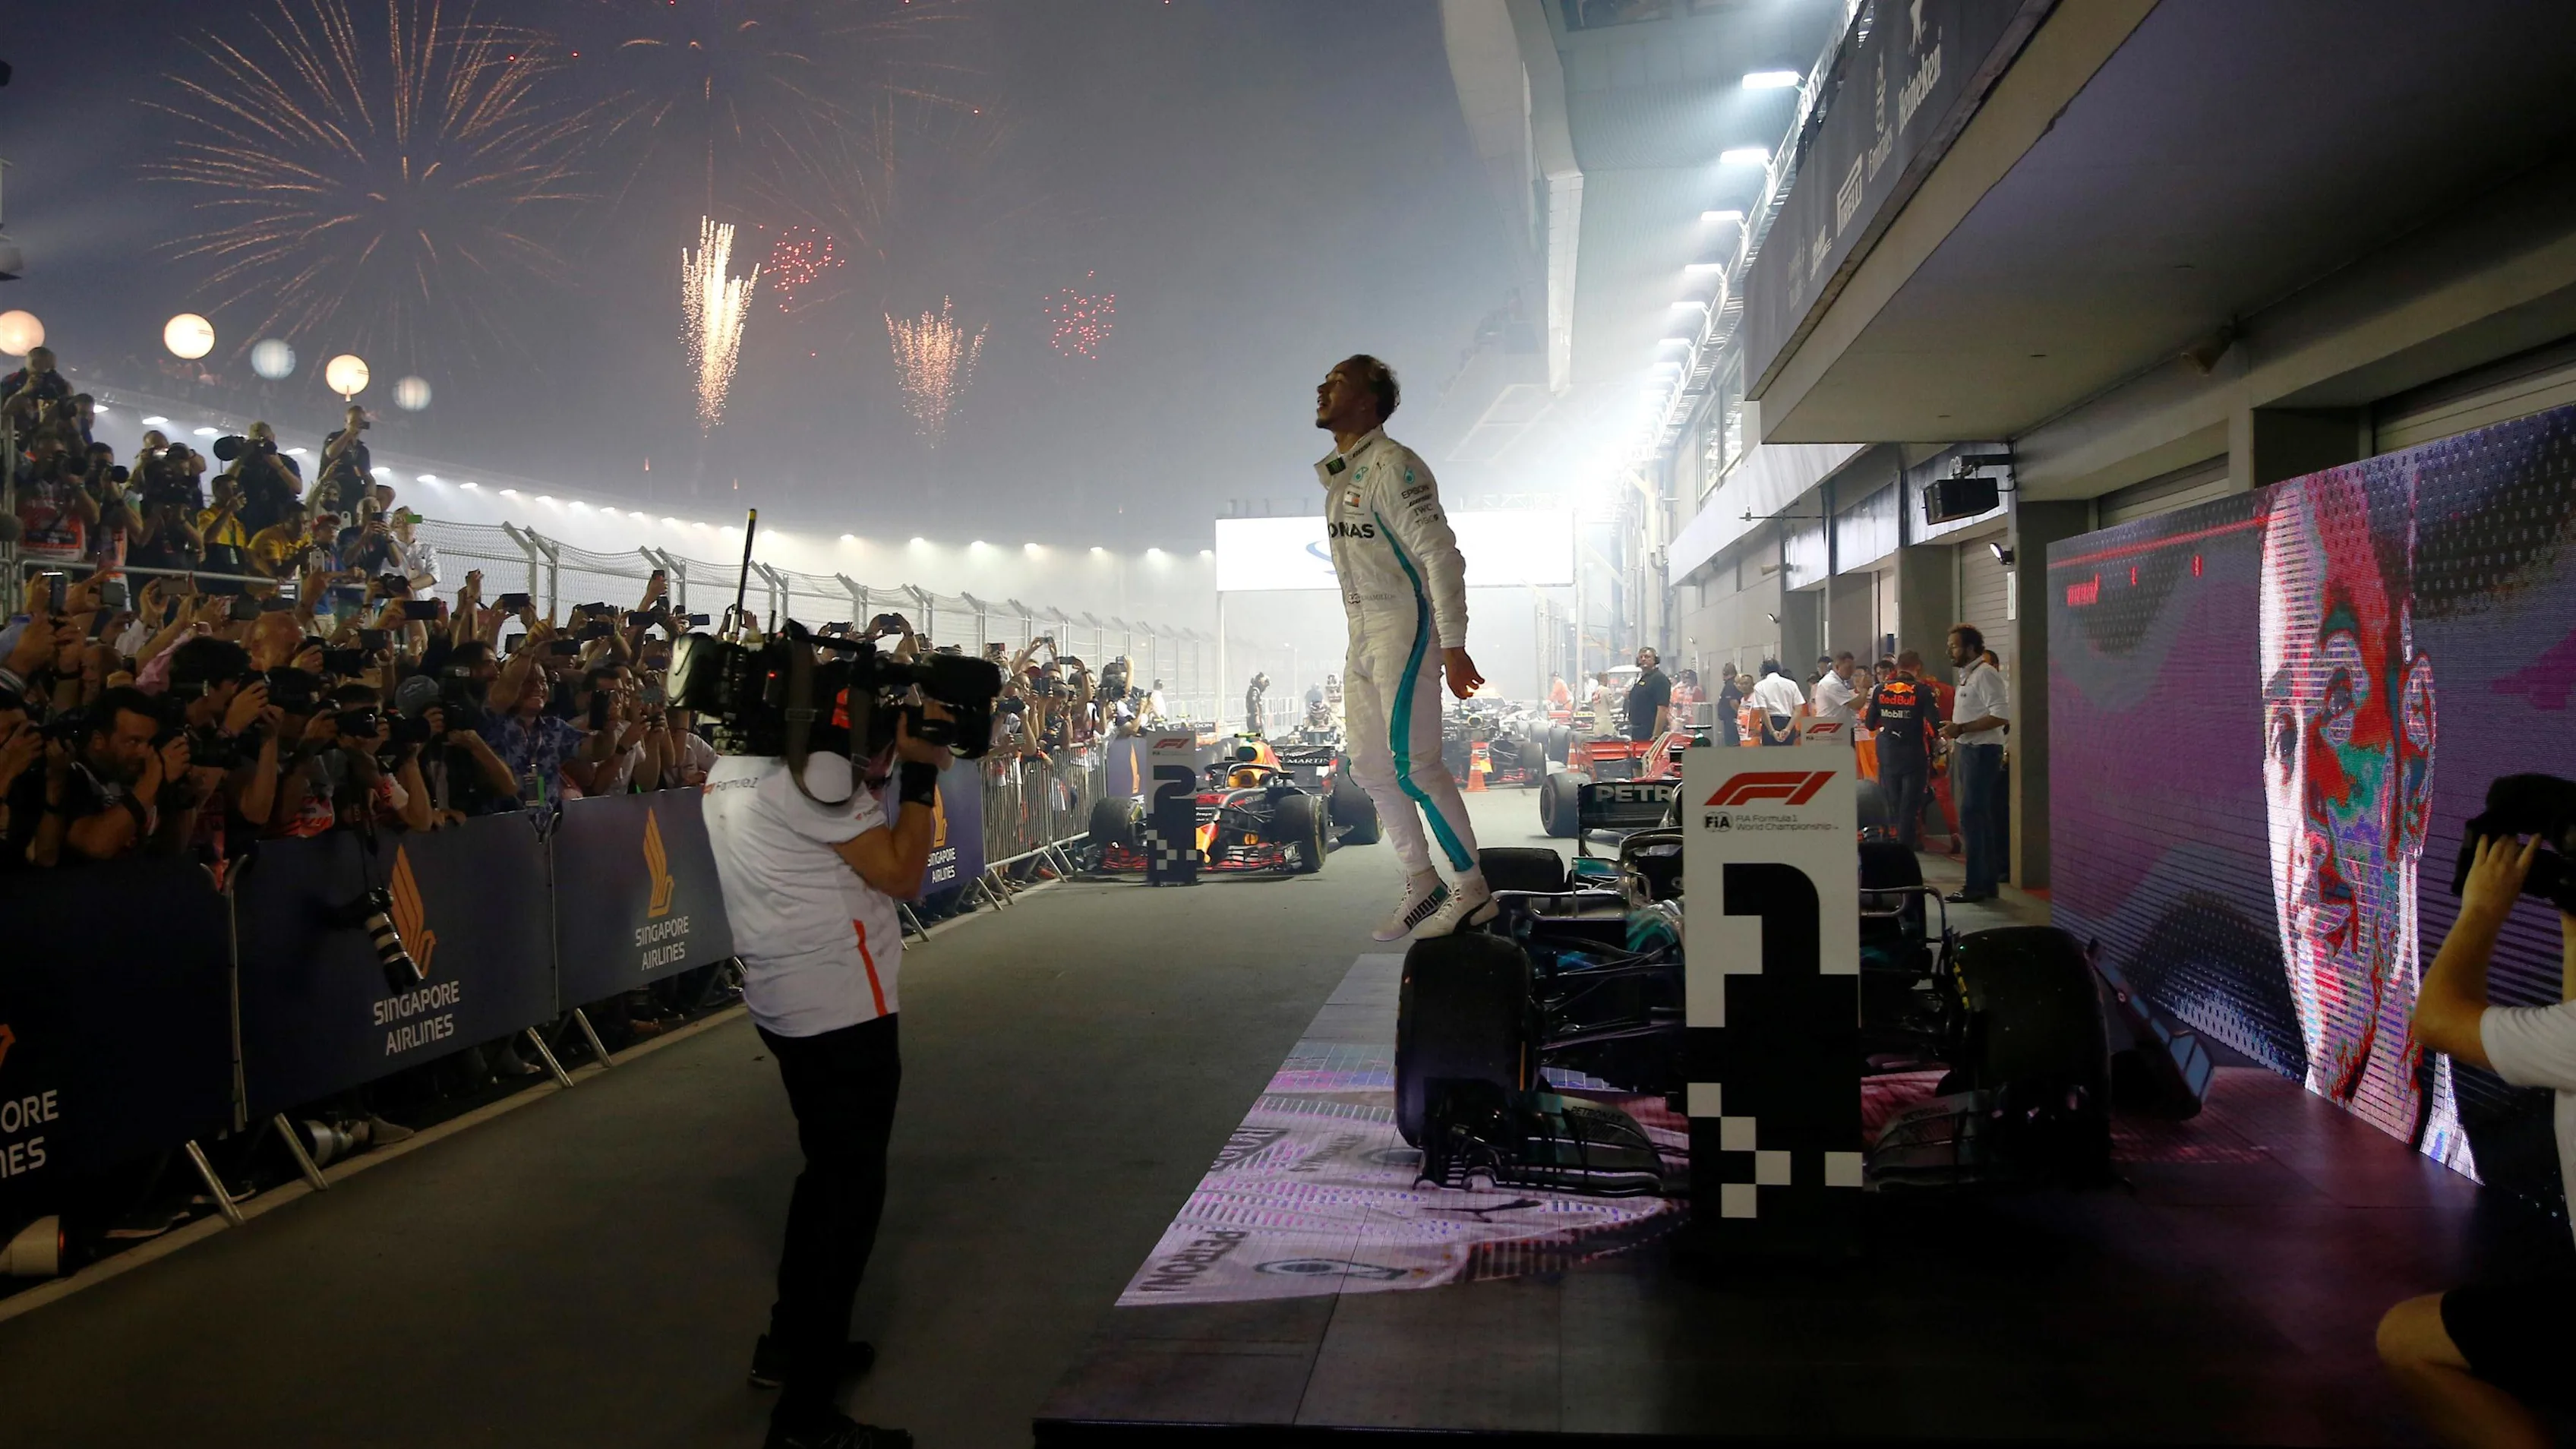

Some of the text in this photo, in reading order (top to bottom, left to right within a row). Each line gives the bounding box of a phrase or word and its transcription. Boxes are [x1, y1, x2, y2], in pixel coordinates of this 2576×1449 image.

[1899, 43, 1941, 136] Heineken
[1837, 153, 1862, 238] PIRELLI
[1401, 485, 1430, 500] EPSON
[1414, 504, 1433, 516] IWC
[927, 847, 957, 867] SINGAPORE
[932, 864, 956, 883] AIRLINES
[635, 916, 690, 947] SINGAPORE
[641, 942, 686, 971] AIRLINES
[373, 980, 460, 1026] SINGAPORE
[386, 1013, 454, 1056] AIRLINES
